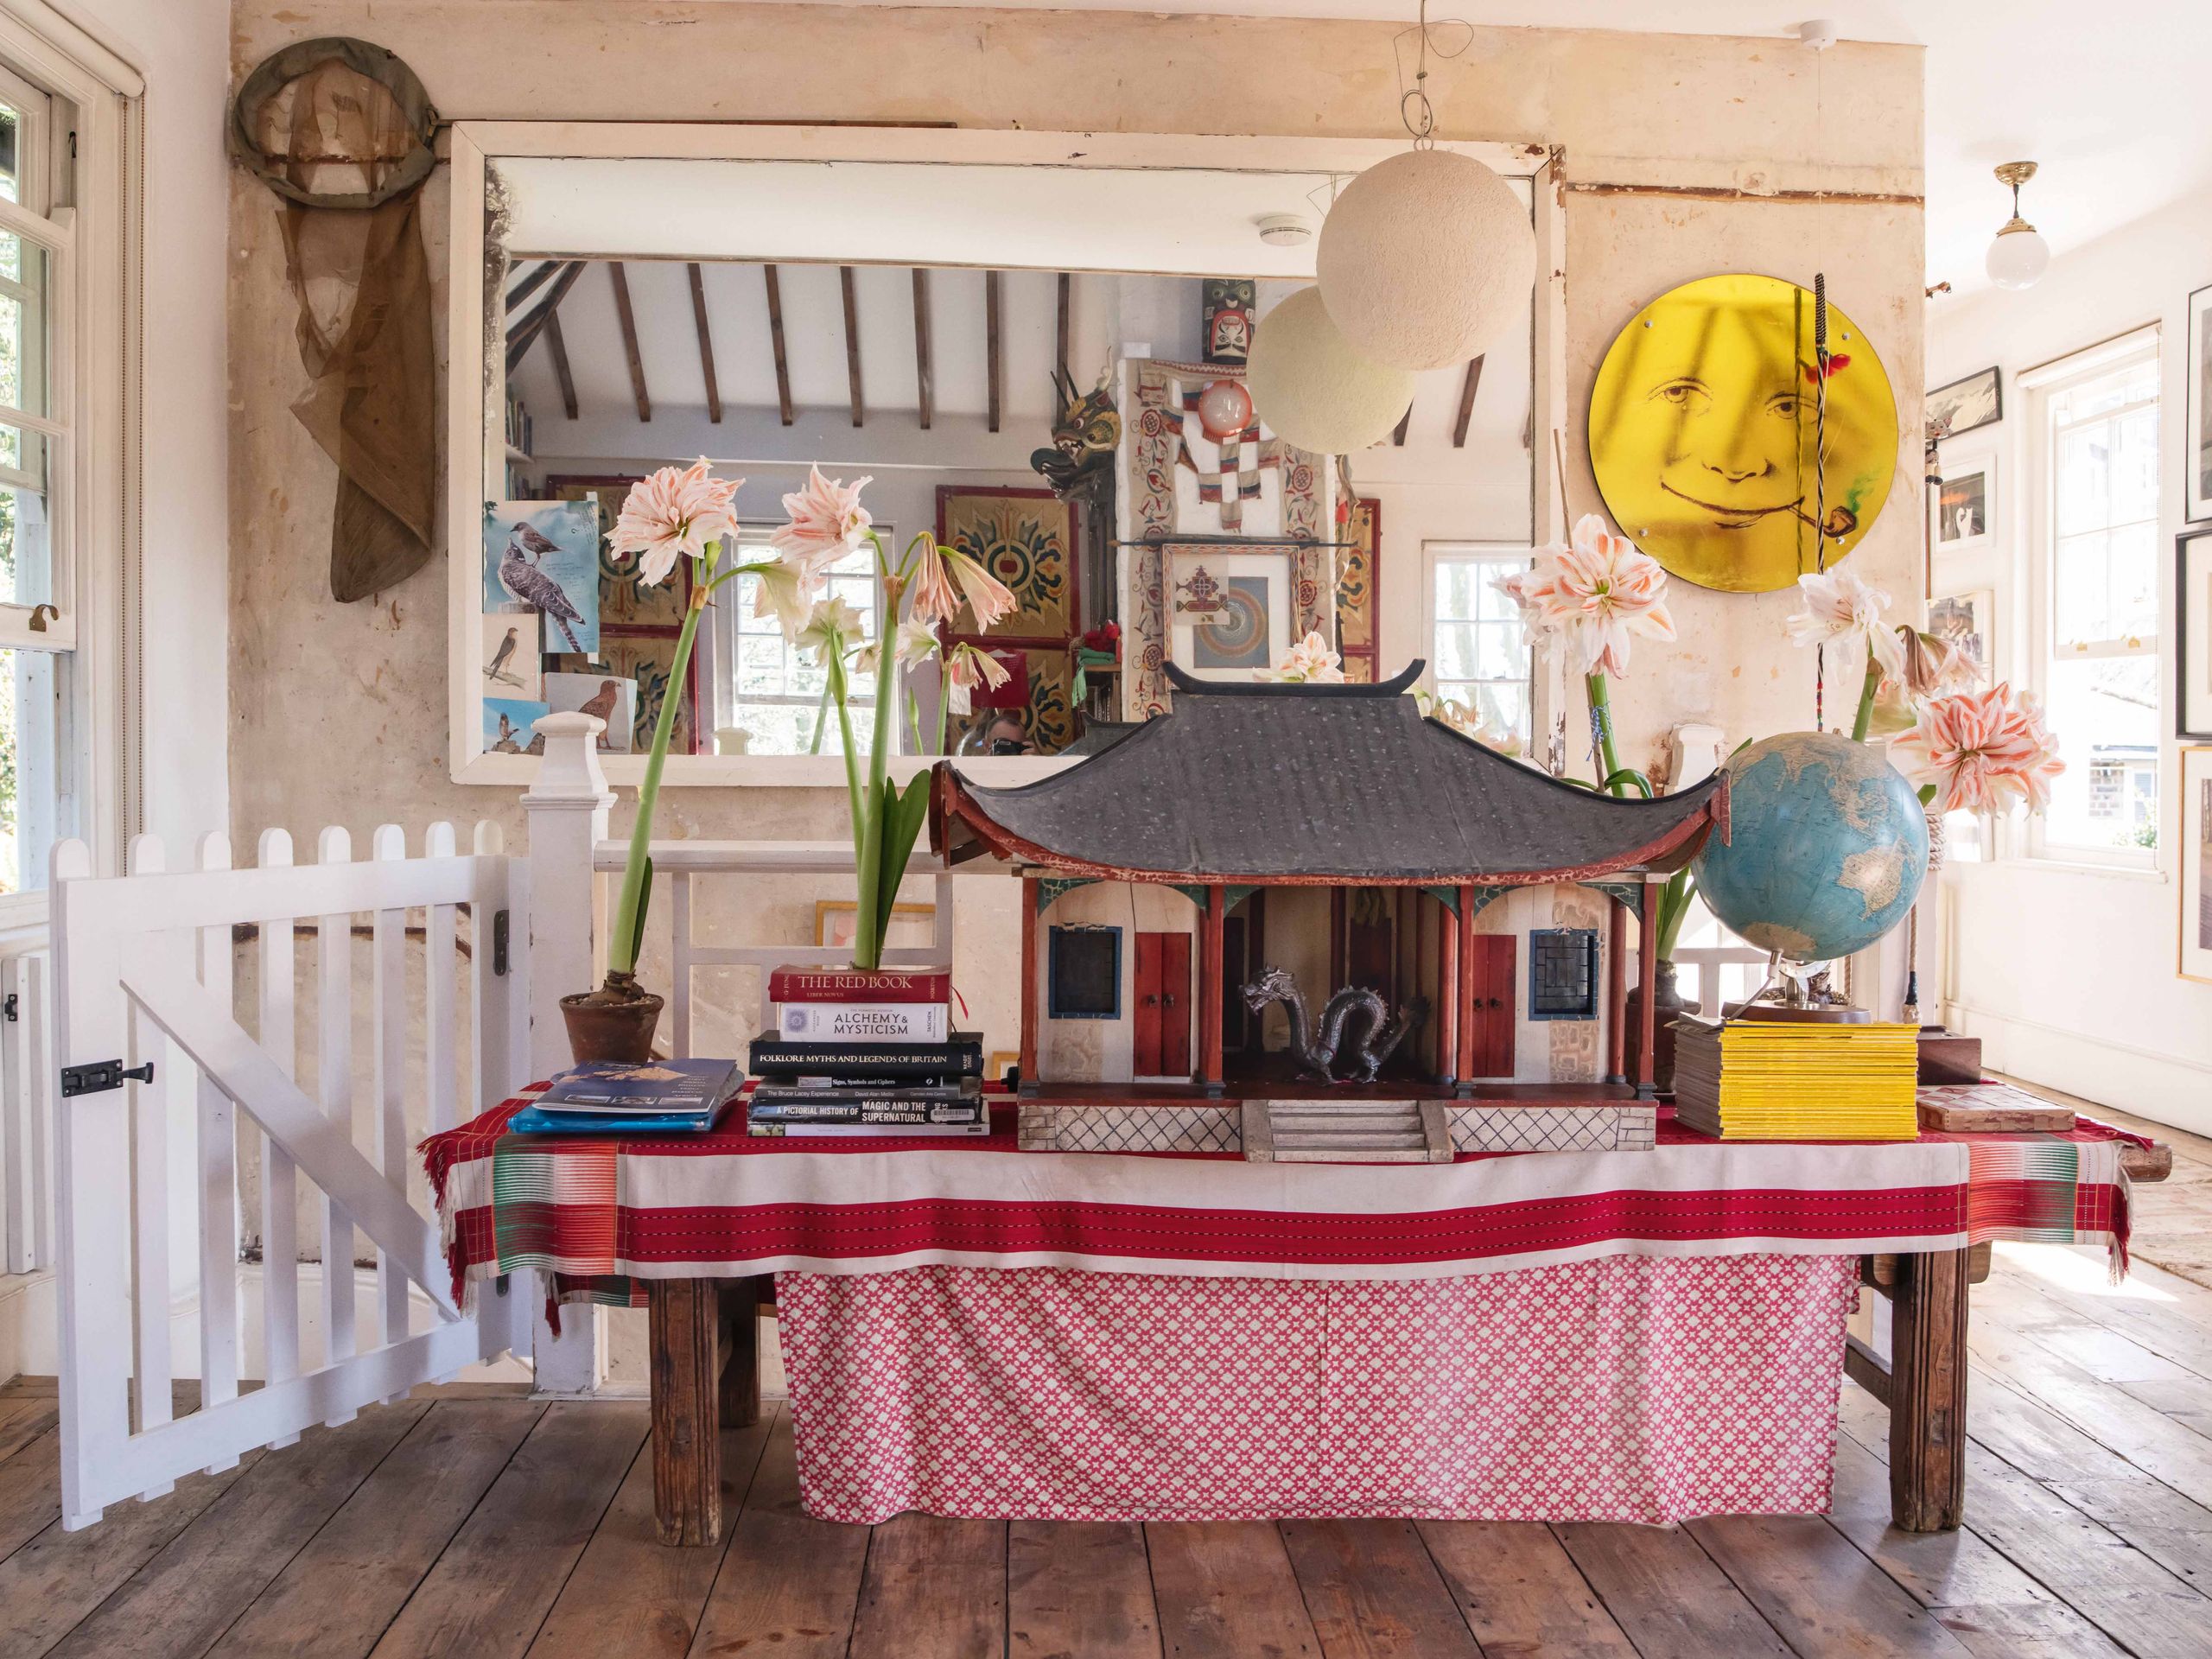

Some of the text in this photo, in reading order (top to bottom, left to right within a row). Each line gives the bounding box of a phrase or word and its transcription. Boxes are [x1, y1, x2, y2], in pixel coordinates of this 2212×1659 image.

[798, 976, 912, 988] THE RED BOOK
[835, 1014, 900, 1023] ALCHEMY
[834, 1024, 908, 1034] MYSTICISM
[862, 1102, 890, 1111] MAGIC
[892, 1102, 910, 1111] AND
[912, 1102, 926, 1111] THE
[819, 1107, 849, 1116] HISTORY
[850, 1107, 859, 1116] OF
[861, 1113, 925, 1122] SUPERNATURAL
